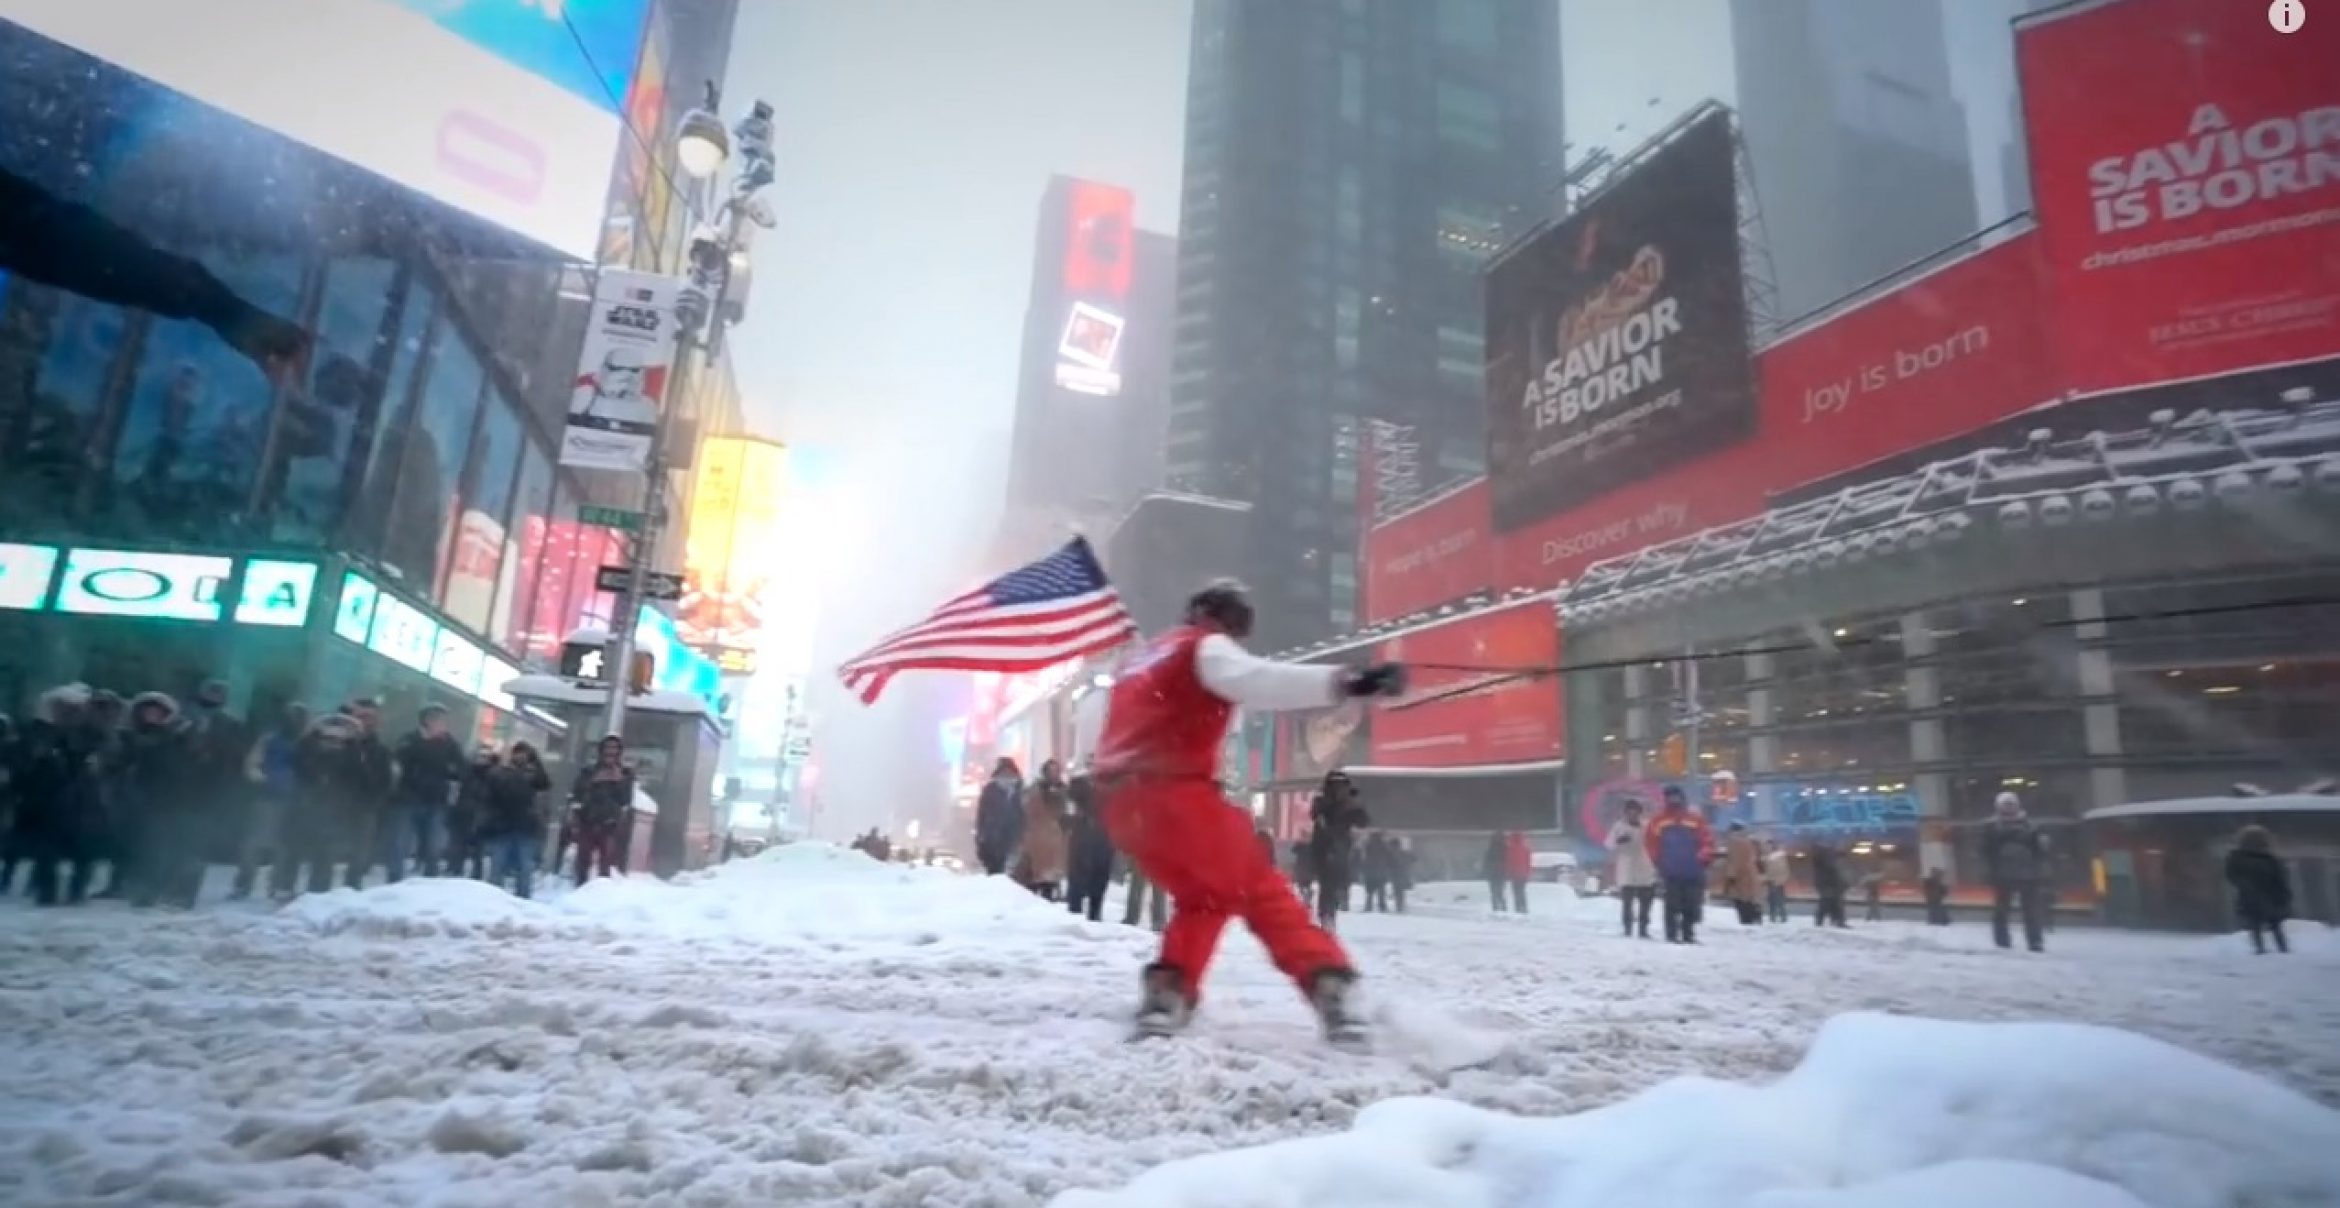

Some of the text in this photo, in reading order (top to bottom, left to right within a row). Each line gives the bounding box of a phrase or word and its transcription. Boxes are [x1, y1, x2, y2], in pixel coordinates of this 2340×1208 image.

[2089, 105, 2340, 198] SAVIOR
[2188, 102, 2228, 135] A
[2095, 191, 2149, 233] IS
[1523, 296, 1682, 410] A SAVIOR
[1536, 344, 1663, 431] IS BORN
[1802, 325, 1990, 424] Joy is born
[1541, 502, 1688, 566] Discover why
